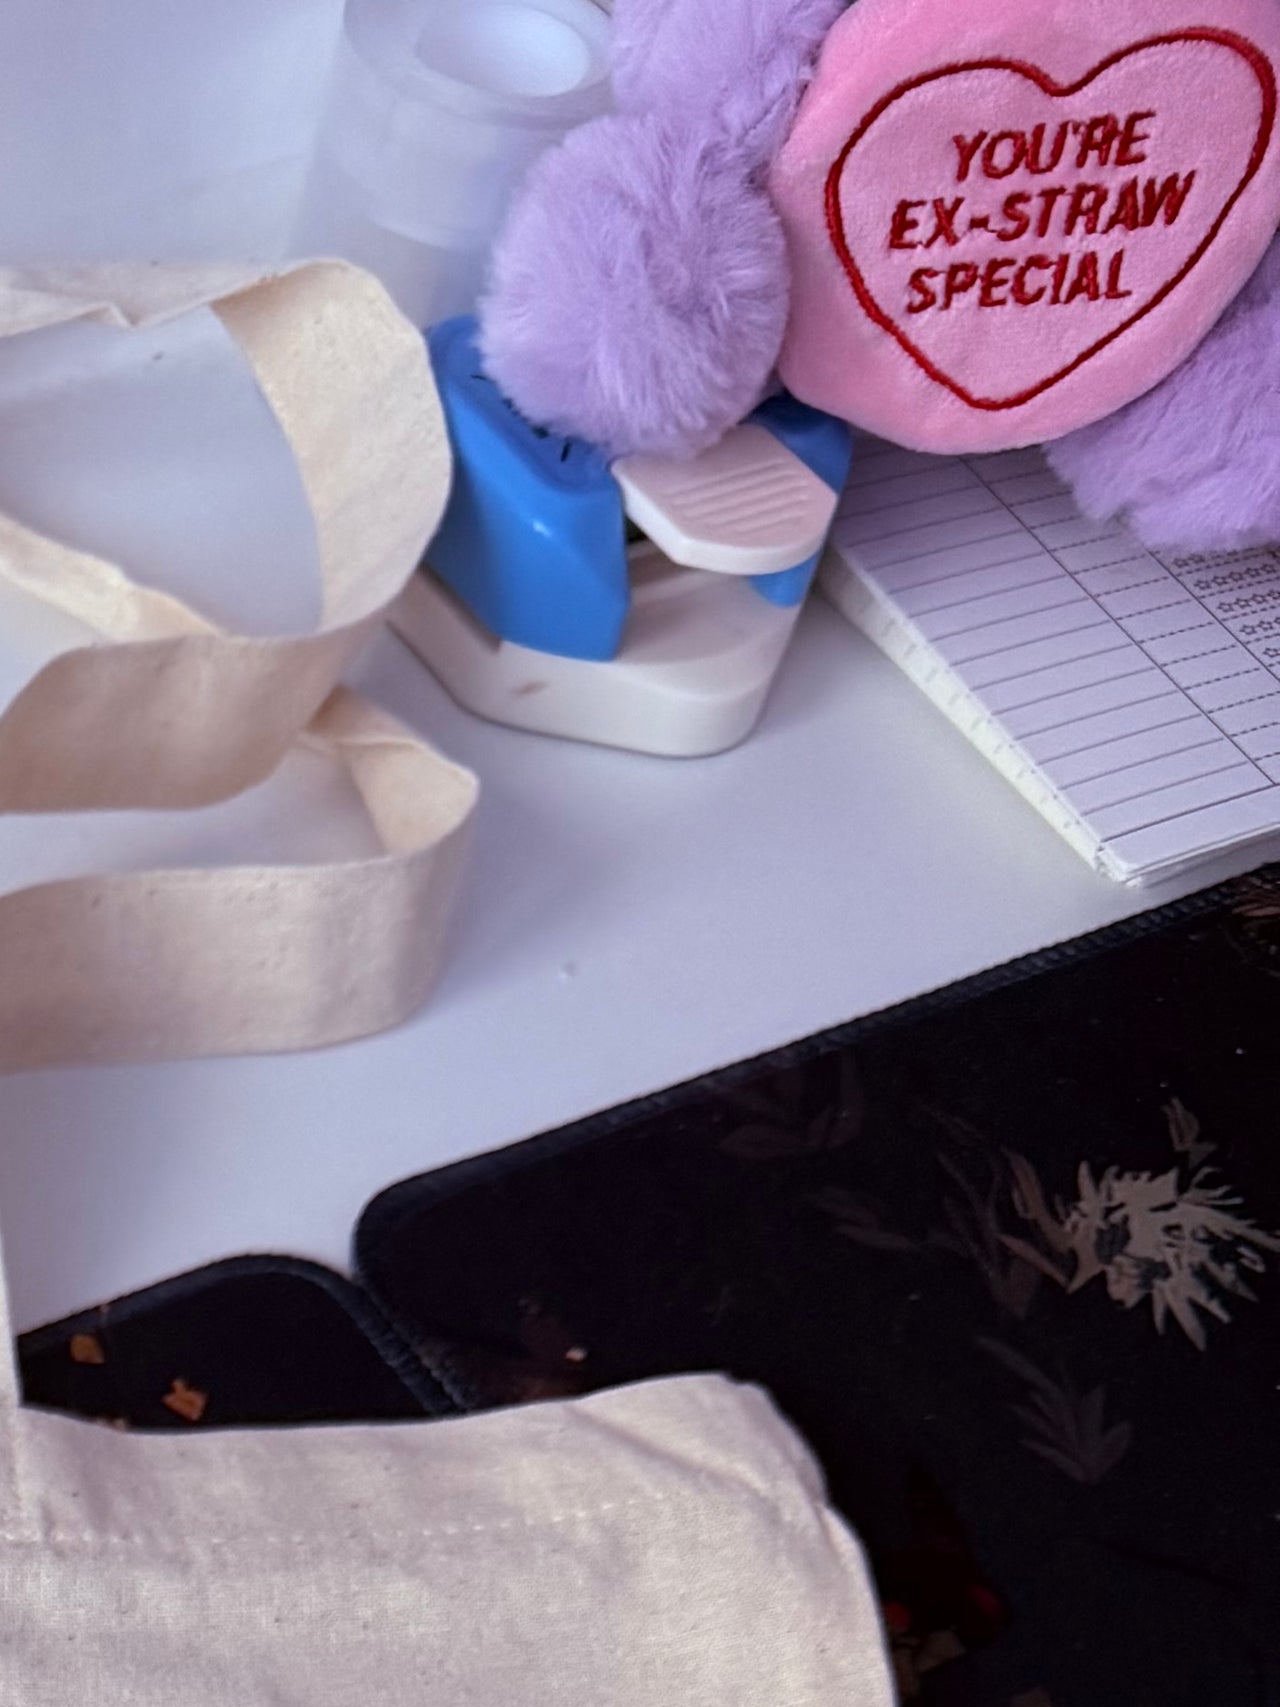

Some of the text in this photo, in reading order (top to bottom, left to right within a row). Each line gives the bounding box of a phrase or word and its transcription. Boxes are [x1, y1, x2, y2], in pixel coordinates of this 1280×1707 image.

[953, 111, 1157, 182] YOU'RE
[889, 170, 1197, 251] EX-STRAW
[907, 251, 1132, 314] SPECIAL
